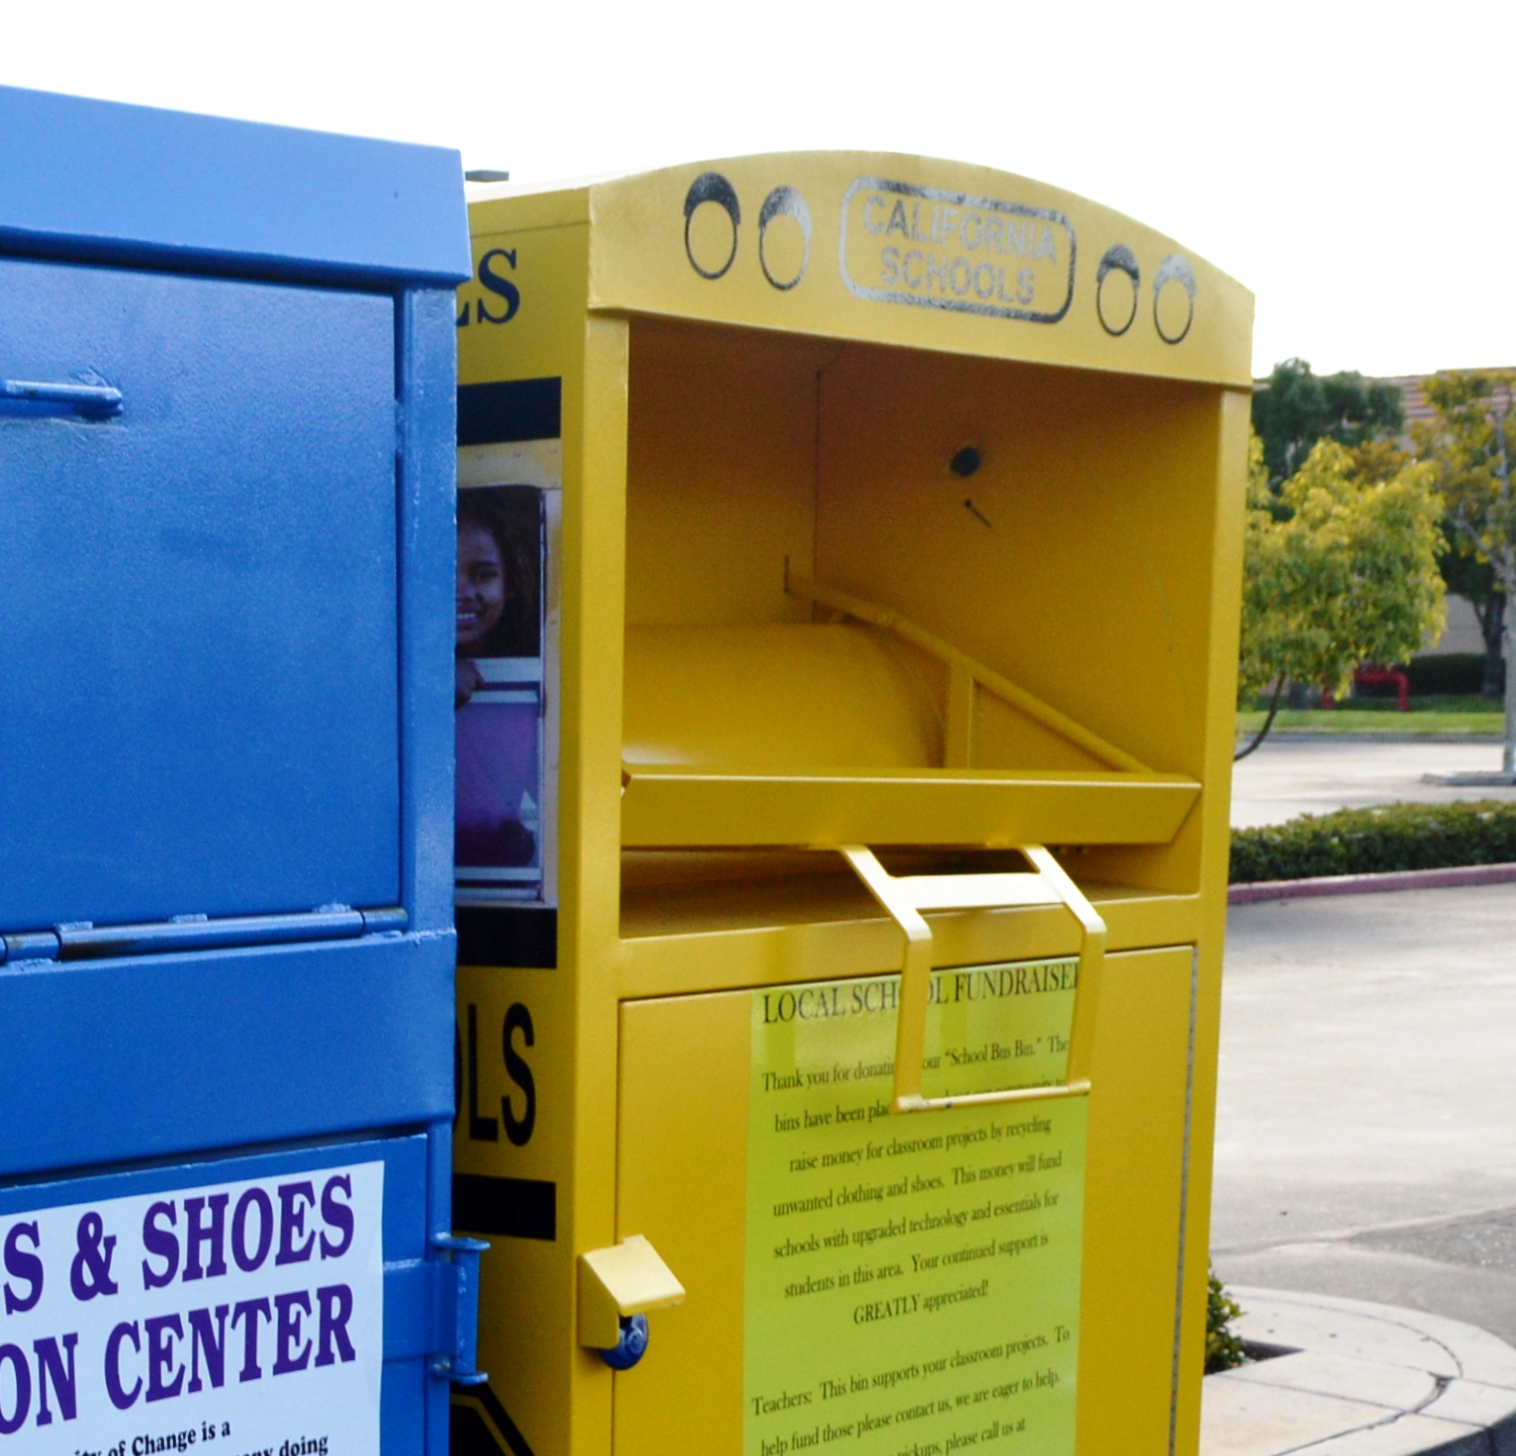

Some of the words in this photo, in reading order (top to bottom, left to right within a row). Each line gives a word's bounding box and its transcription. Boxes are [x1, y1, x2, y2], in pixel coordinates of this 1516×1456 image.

[864, 195, 1056, 263] CALIFORNIA
[881, 246, 1035, 304] SCHOOLS
[763, 987, 846, 1024] LOCAL
[762, 1069, 803, 1092] Thank
[807, 1071, 830, 1089] you
[834, 1062, 851, 1082] for
[991, 1041, 1011, 1061] Bus
[1048, 1034, 1069, 1053] The
[789, 1152, 819, 1173] raise
[821, 1149, 863, 1171] money
[866, 1141, 884, 1160] for
[886, 1136, 943, 1157] classroom
[945, 1128, 988, 1152] projects
[990, 1122, 1004, 1142] by
[1005, 1116, 1052, 1138] recycling
[773, 1188, 833, 1218] unwanted
[836, 1184, 884, 1206] clothing
[886, 1176, 908, 1197] and
[911, 1174, 945, 1193] shoes.
[951, 1166, 977, 1186] This
[979, 1163, 1015, 1184] money
[1018, 1154, 1036, 1173] will
[1038, 1149, 1062, 1170] fund
[70, 1211, 118, 1302] &
[142, 1173, 354, 1291] SHOES
[853, 1293, 920, 1325] GREATLY
[922, 1278, 989, 1313] appreciated!
[104, 1284, 356, 1410] CENTER
[201, 1420, 216, 1442] is
[221, 1420, 231, 1438] a
[945, 1432, 978, 1456] please
[981, 1420, 999, 1442] call
[1001, 1423, 1014, 1436] us
[1015, 1417, 1026, 1433] at
